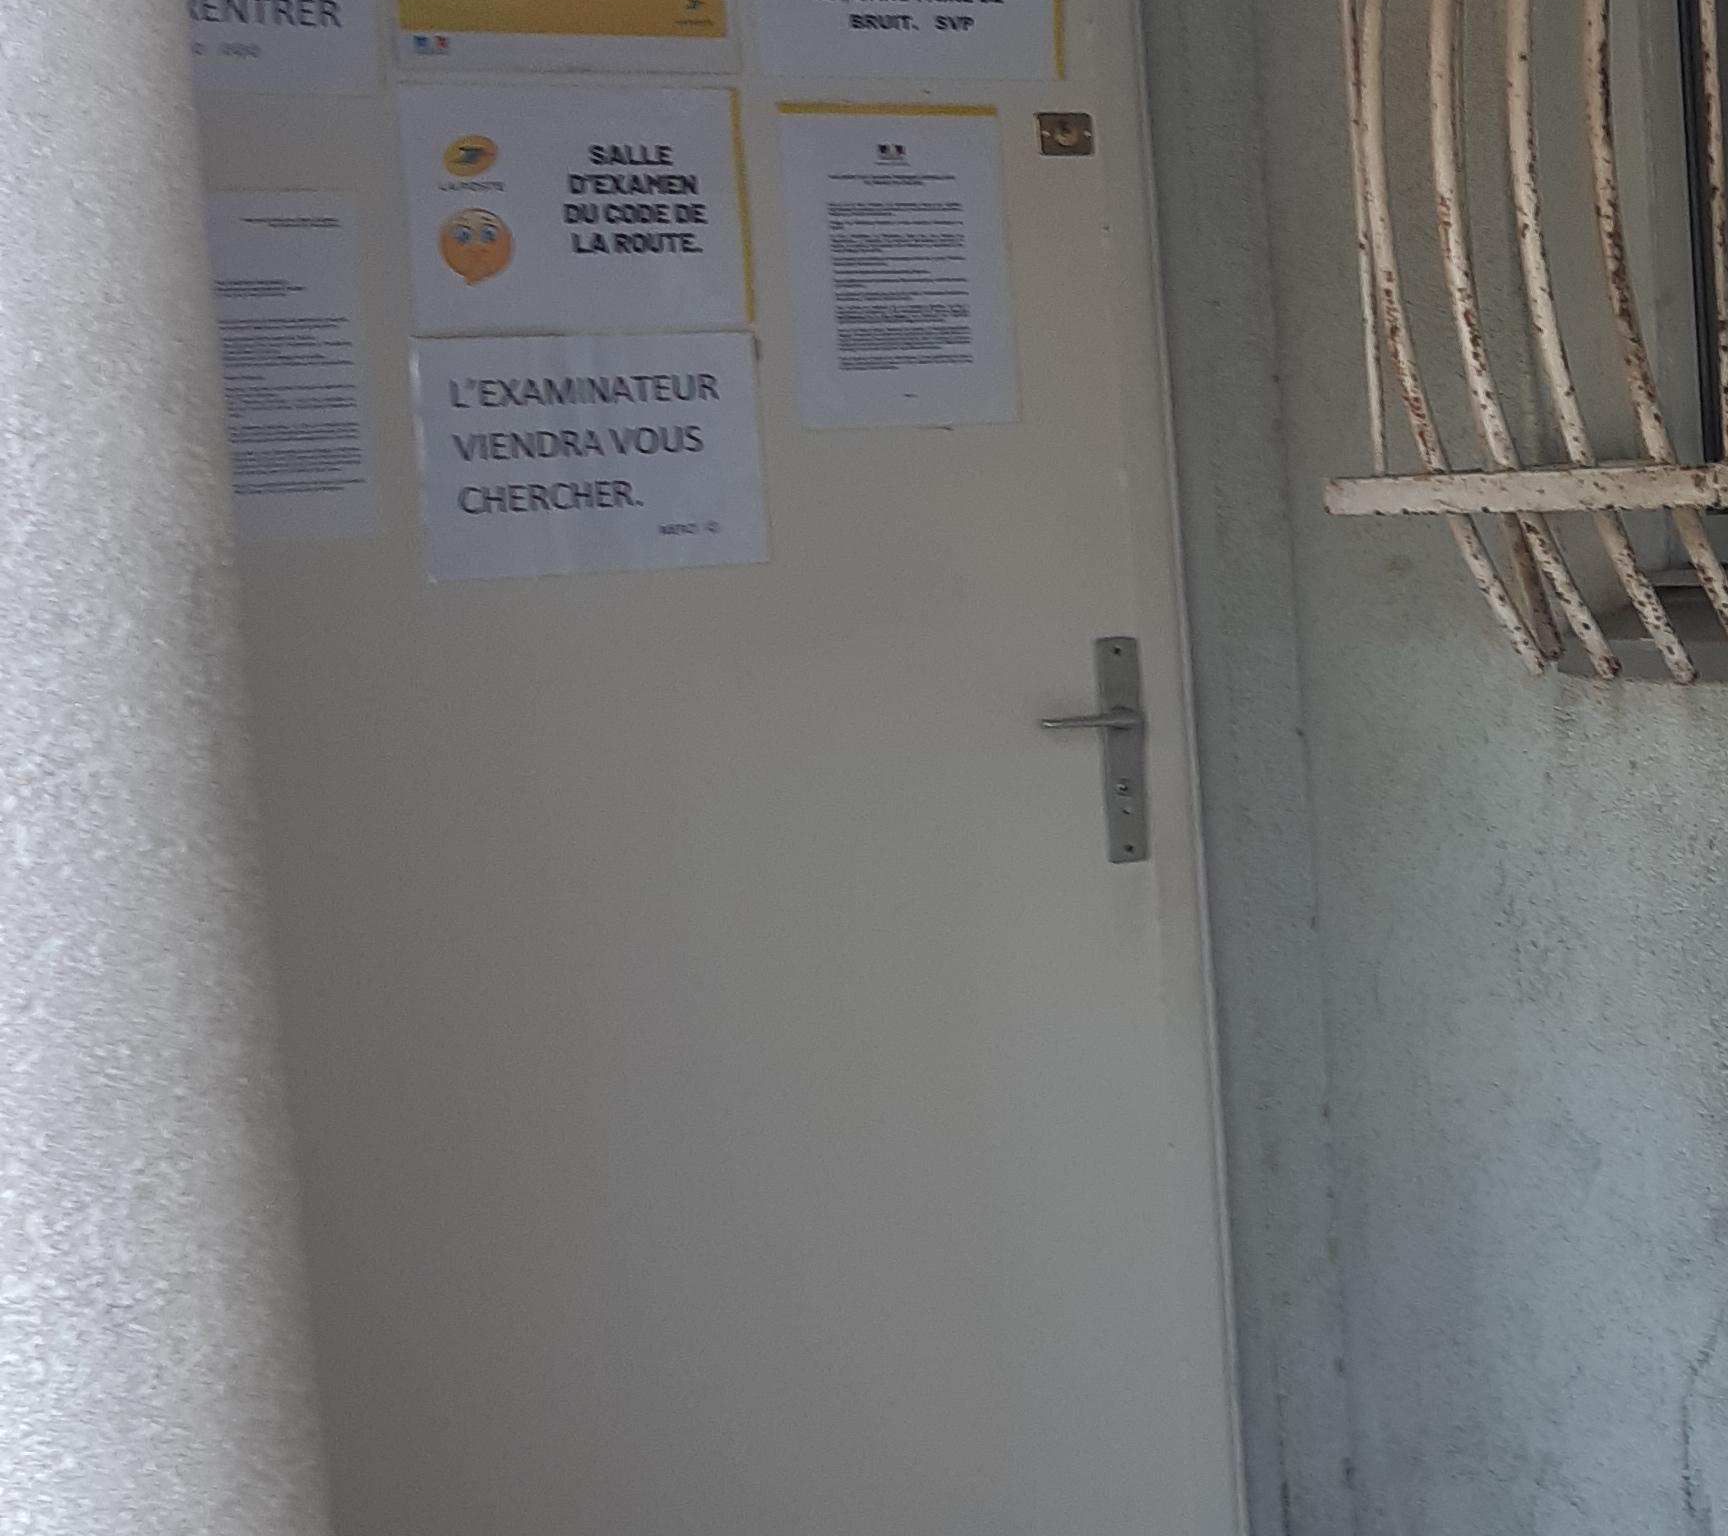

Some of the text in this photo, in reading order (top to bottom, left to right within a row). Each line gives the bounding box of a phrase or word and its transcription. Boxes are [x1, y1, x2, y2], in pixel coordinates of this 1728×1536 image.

[934, 14, 976, 32] SVP
[588, 144, 674, 166] SALLE
[567, 173, 698, 196] D'EXAMEN
[563, 202, 708, 225] DU CODE DE
[571, 232, 704, 255] LA ROUTE.
[449, 372, 720, 409] L'EXAMINATEUR
[451, 425, 705, 462] VIENDRA VOUS
[458, 479, 645, 514] CHERCHER.
